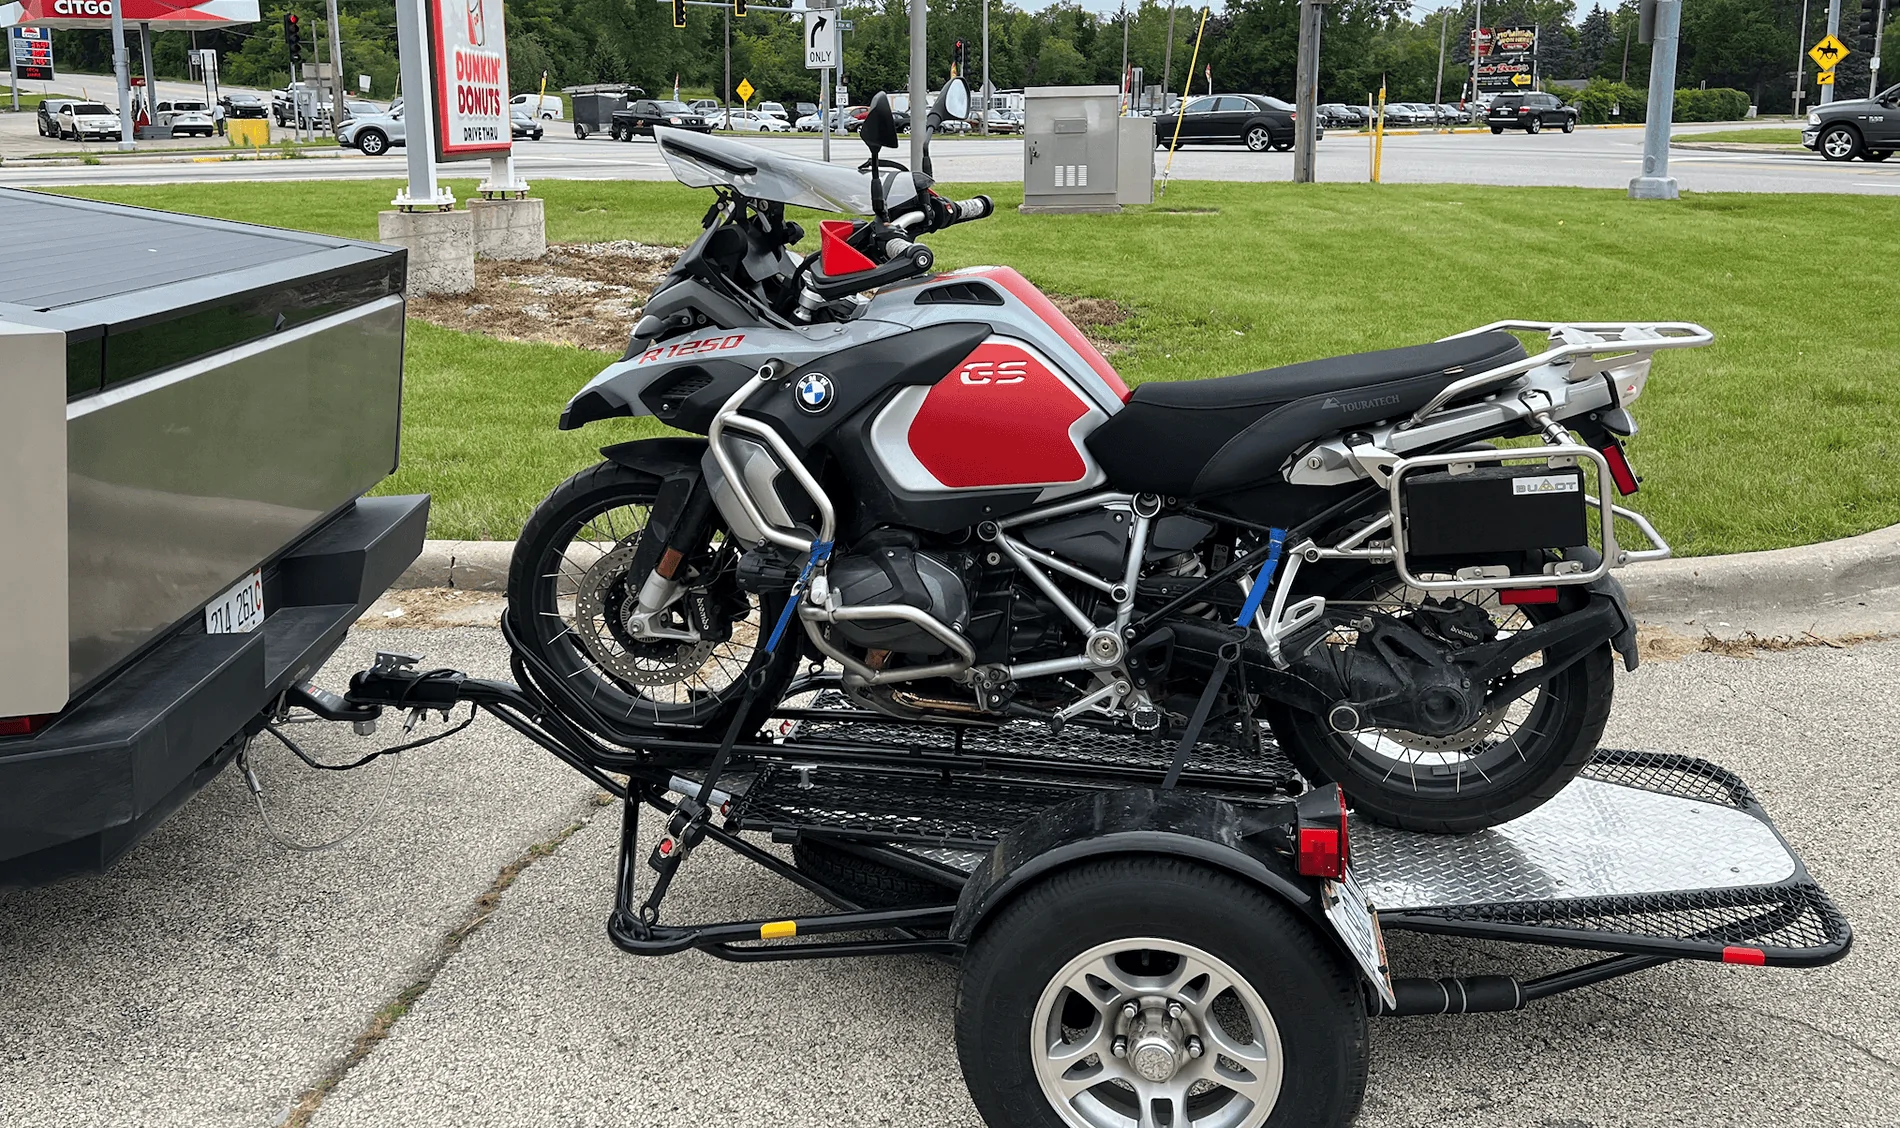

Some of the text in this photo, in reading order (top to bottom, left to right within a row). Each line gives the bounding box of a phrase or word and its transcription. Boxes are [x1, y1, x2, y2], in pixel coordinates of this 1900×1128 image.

[54, 0, 112, 15] CITGO
[809, 51, 832, 63] ONLY
[455, 51, 500, 84] DUNKIN'
[457, 84, 500, 116] DONUTS
[463, 127, 498, 141] DRIVE THRU
[638, 334, 746, 365] R 1250
[798, 374, 829, 389] BMW
[959, 361, 1028, 385] GS
[1340, 394, 1400, 413] TOURATECH
[696, 597, 710, 631] brembo
[1450, 624, 1479, 641] brembo
